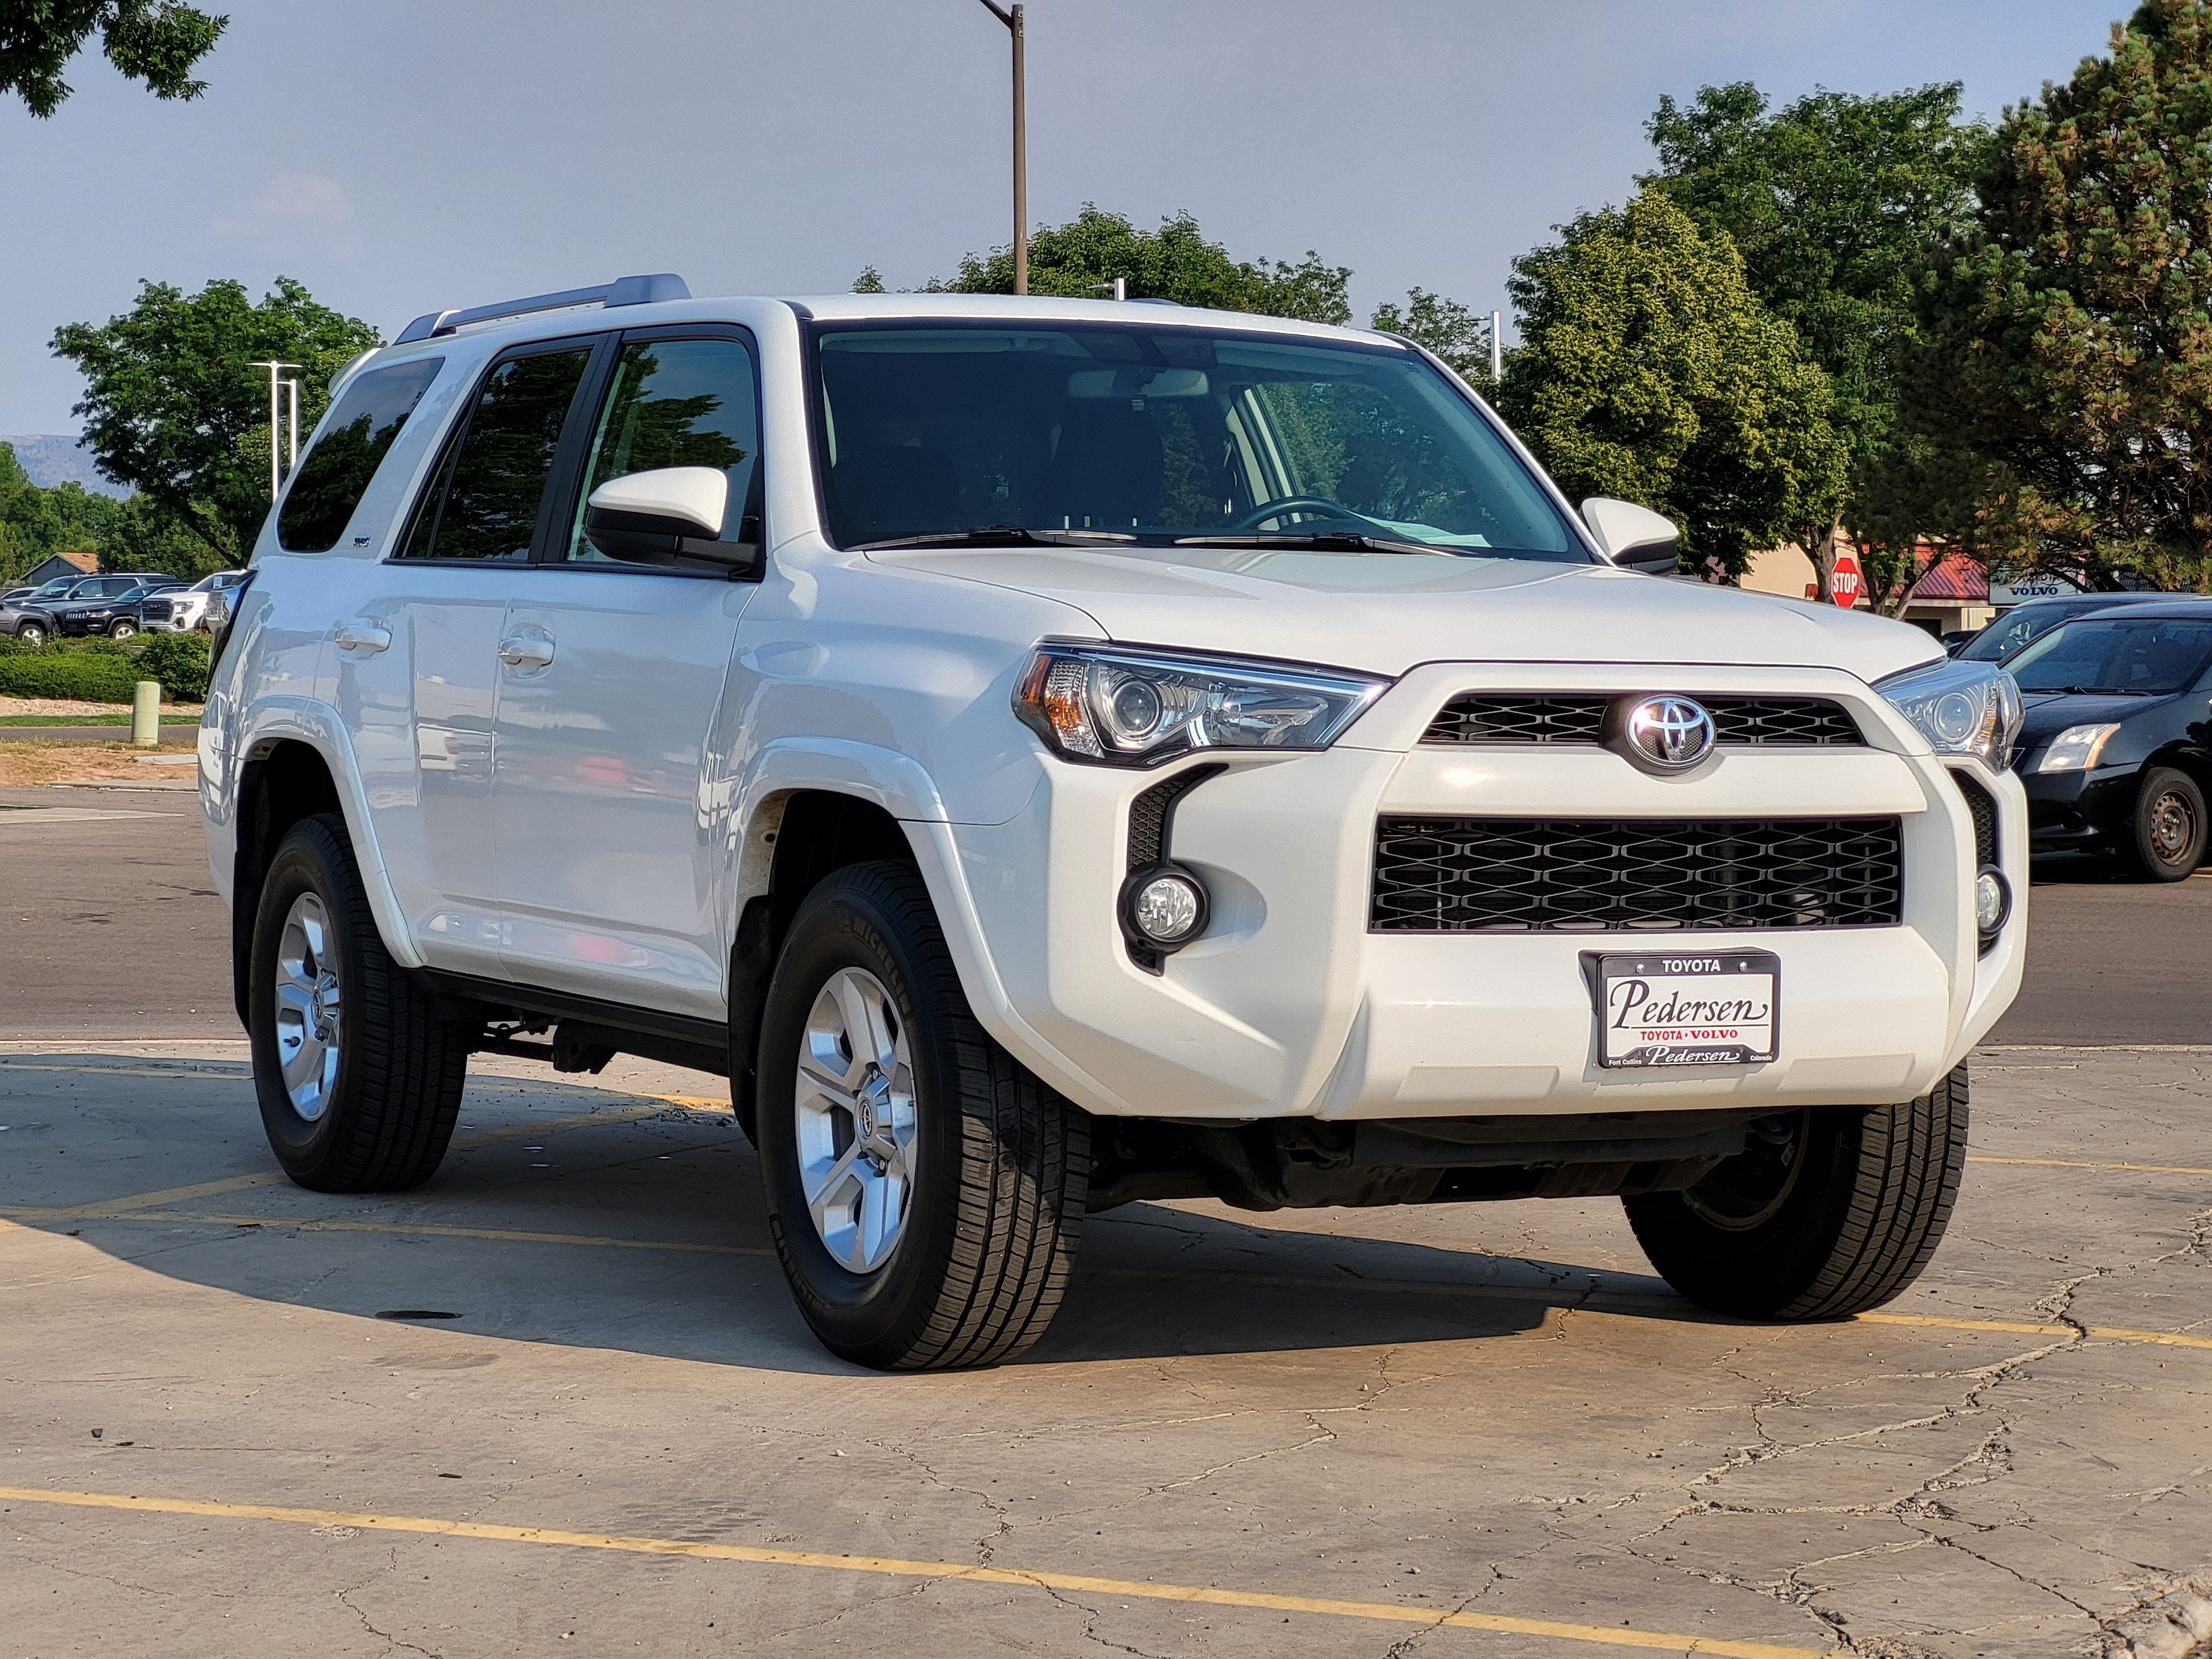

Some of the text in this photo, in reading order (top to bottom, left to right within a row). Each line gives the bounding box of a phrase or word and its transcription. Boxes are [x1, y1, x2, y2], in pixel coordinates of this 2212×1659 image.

[1833, 572, 1858, 594] STOP
[2009, 587, 2058, 596] VOLVO
[852, 916, 912, 1016] MICHELIN
[1662, 959, 1721, 973] TOYOTA
[1609, 979, 1768, 1030] Pedersen
[1640, 1029, 1738, 1041] TOYOTA VOLVO
[1646, 1045, 1740, 1065] Pedersen
